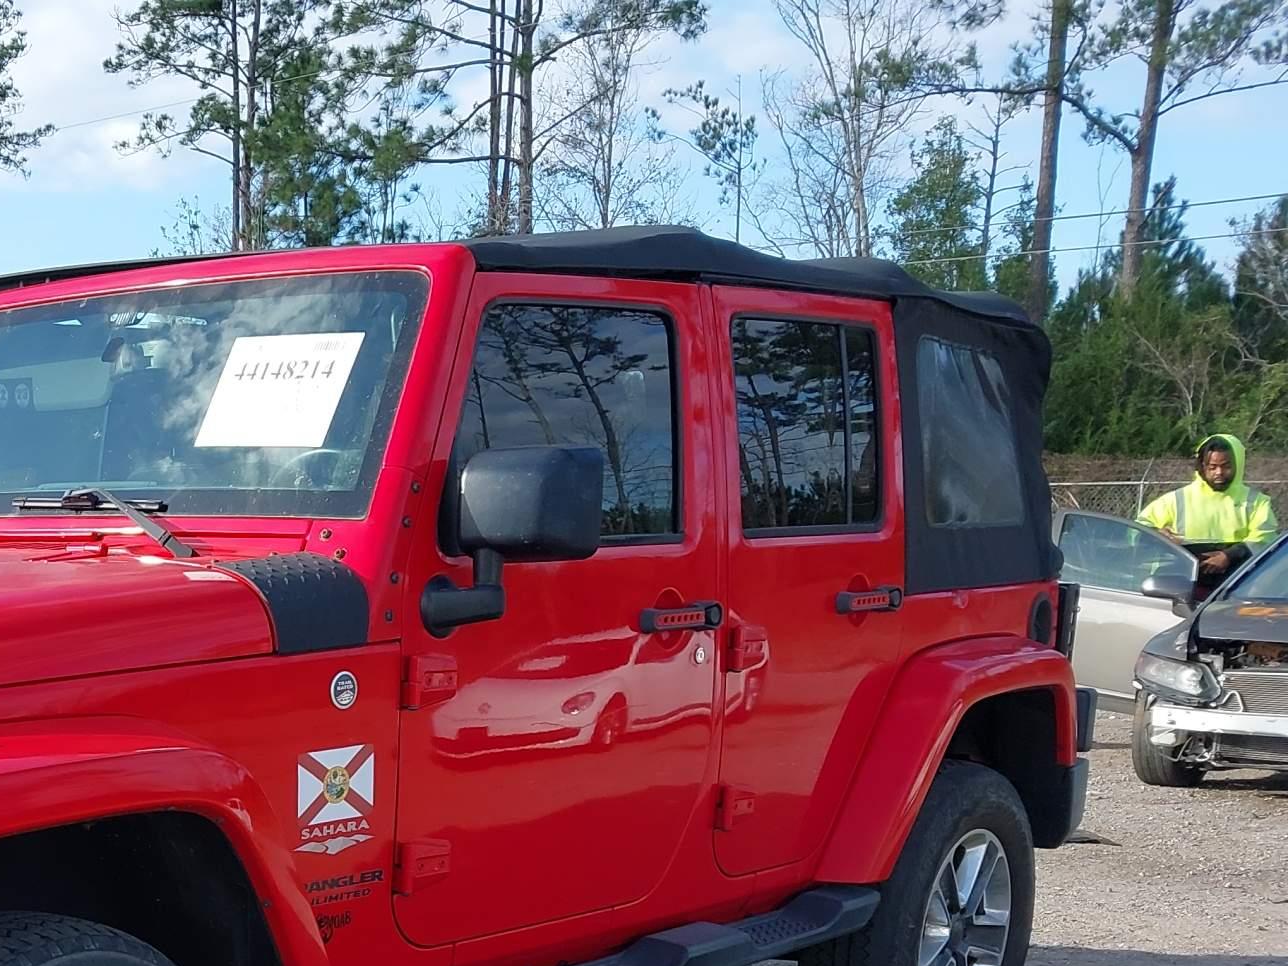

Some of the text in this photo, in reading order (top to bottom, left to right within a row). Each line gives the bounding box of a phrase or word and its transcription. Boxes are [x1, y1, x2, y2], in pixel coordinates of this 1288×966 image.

[234, 359, 336, 381] 44148214
[300, 818, 370, 840] SAHARA
[305, 869, 384, 893] ANGLER
[312, 888, 371, 906] LIMITED
